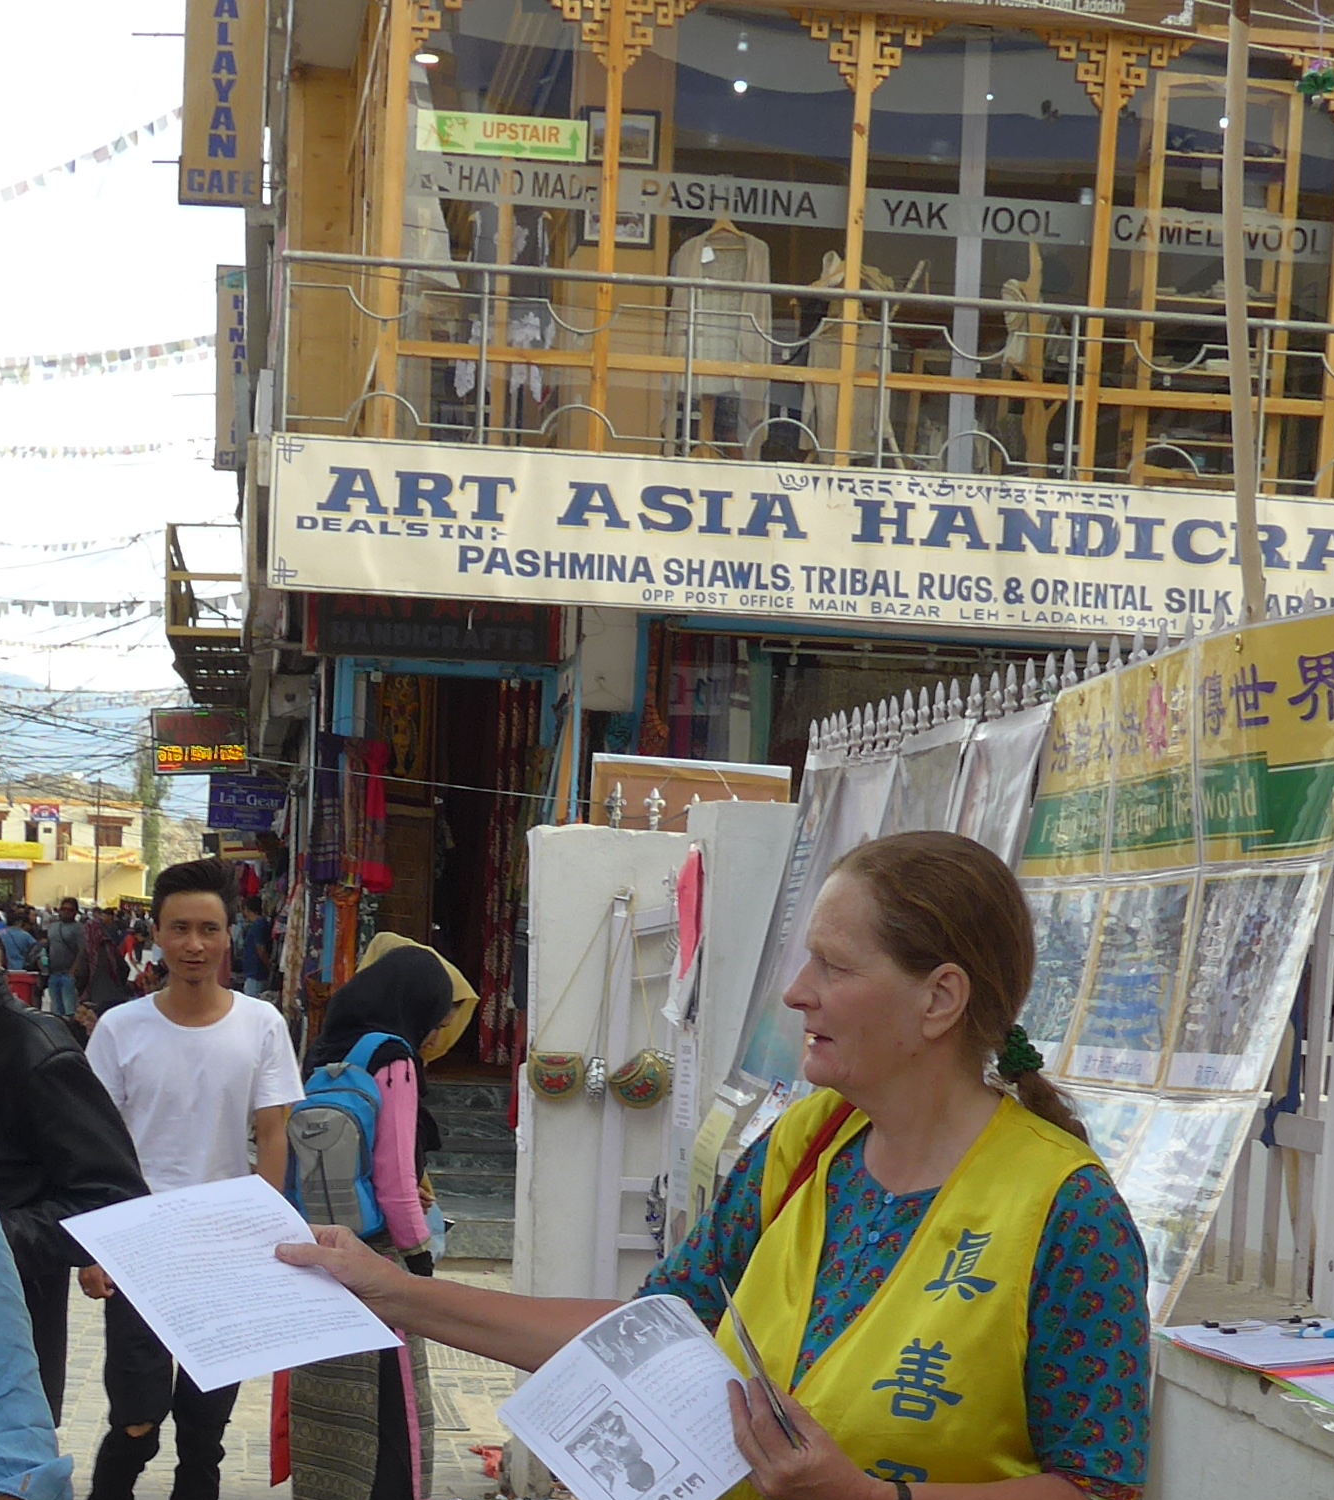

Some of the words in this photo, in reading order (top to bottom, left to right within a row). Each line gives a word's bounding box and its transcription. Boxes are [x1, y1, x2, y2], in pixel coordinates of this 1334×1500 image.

[482, 120, 561, 145] UPSTAIR
[187, 167, 256, 196] CAFE
[458, 164, 524, 195] HAND
[641, 178, 818, 219] PASHMINA
[882, 198, 950, 231] YAK
[1114, 214, 1222, 249] CAMEL
[316, 465, 517, 523] ART
[557, 479, 808, 542] ASIA
[296, 513, 430, 538] DEAL'S
[457, 545, 655, 586] PASHMINA
[800, 565, 909, 600] TRIBAL
[1003, 577, 1025, 606] &
[1030, 578, 1154, 613] ORIENTAL
[1167, 586, 1234, 616] SILK
[684, 591, 730, 606] POST
[739, 594, 795, 610] OFFICE
[809, 598, 858, 613] MAIN
[870, 601, 942, 619] BAZAR
[958, 608, 999, 624] LEH
[331, 620, 536, 651] HANDICRAFTS
[1203, 776, 1258, 822] World
